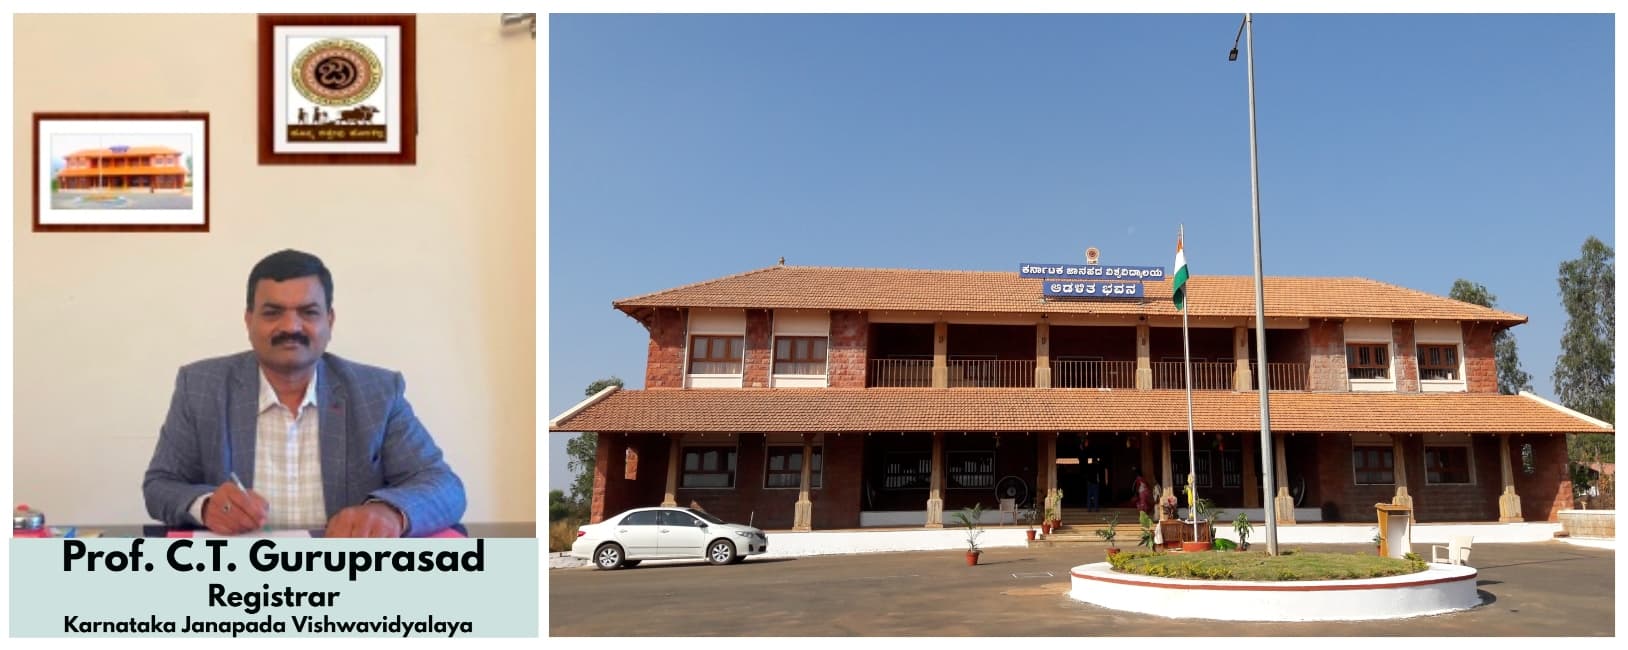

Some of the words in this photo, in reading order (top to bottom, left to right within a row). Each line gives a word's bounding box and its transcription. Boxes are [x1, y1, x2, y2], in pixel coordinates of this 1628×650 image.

[1022, 265, 1064, 274] ಕರ್ನಾಟಕ
[1066, 267, 1103, 276] ಜಾನಪದ
[1105, 268, 1162, 279] ವಿಶ್ವವಿದ್ಯಾಲಯ
[1101, 284, 1136, 295] ಭವನ
